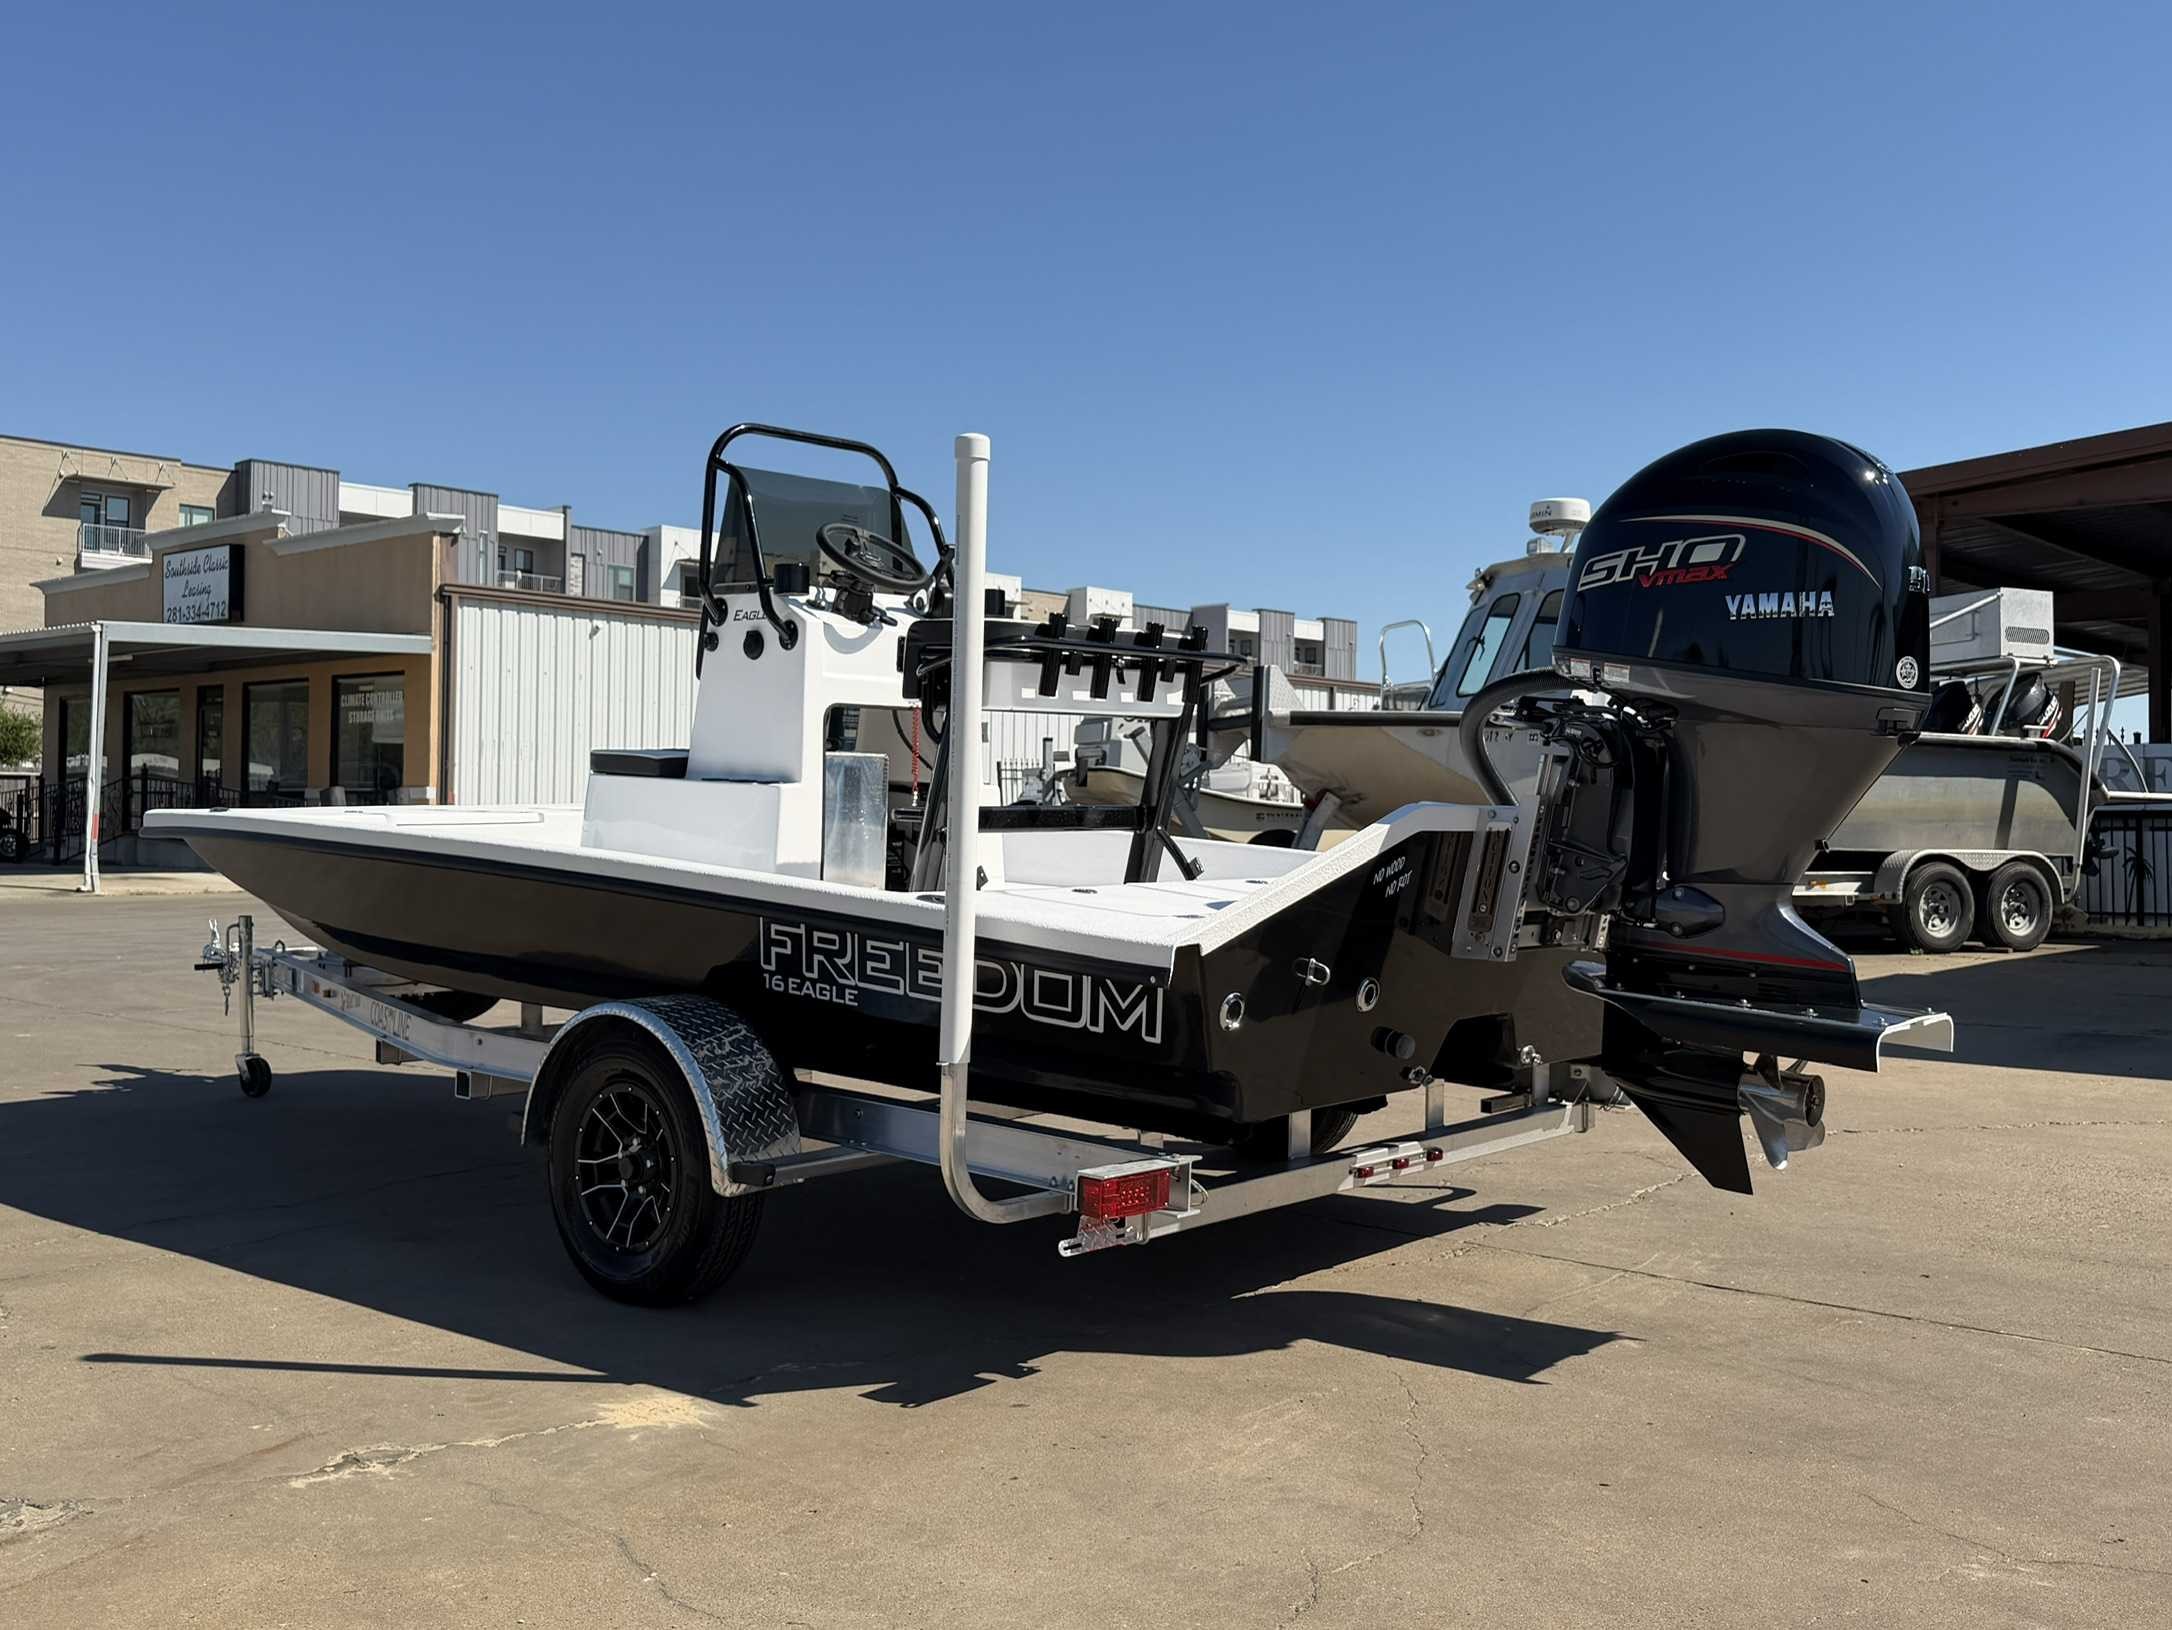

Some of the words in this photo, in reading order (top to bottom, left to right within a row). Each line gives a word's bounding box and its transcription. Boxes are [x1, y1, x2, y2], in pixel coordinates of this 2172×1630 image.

[165, 556, 201, 579] Southside
[203, 553, 229, 574] Classic
[1577, 534, 1747, 592] SHO
[181, 580, 212, 602] Leasing
[1725, 591, 1835, 620] YAMAHA
[166, 600, 227, 623] 281-334-4712
[1373, 867, 1385, 885] NO
[1386, 856, 1405, 878] WOOD
[1385, 880, 1397, 898] NO
[1397, 870, 1412, 892] ROT
[759, 916, 1164, 1044] FREEDOM
[763, 973, 785, 992] 16
[788, 977, 858, 1006] EAGLE
